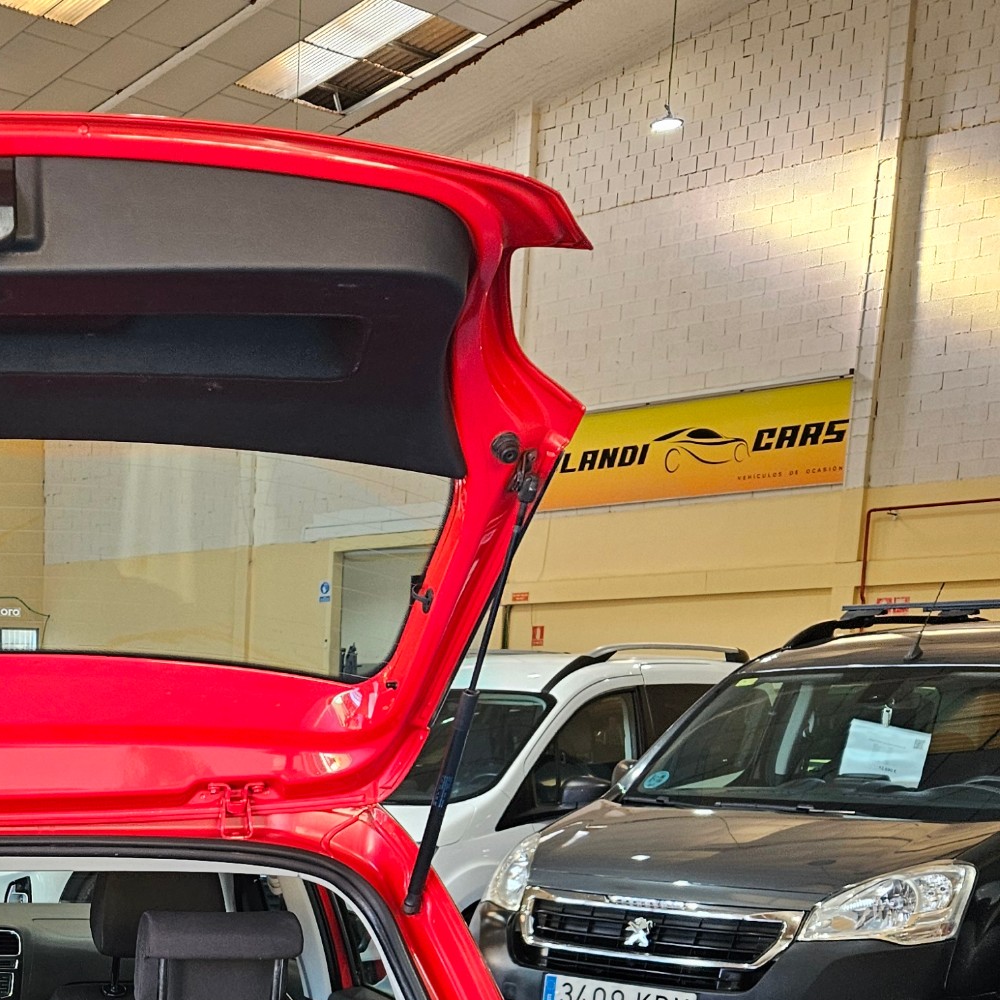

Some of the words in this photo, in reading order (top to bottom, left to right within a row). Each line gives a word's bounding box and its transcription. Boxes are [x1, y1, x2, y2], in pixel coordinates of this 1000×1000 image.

[556, 444, 650, 474] LANDI
[752, 418, 850, 453] CARS
[789, 469, 799, 477] DE
